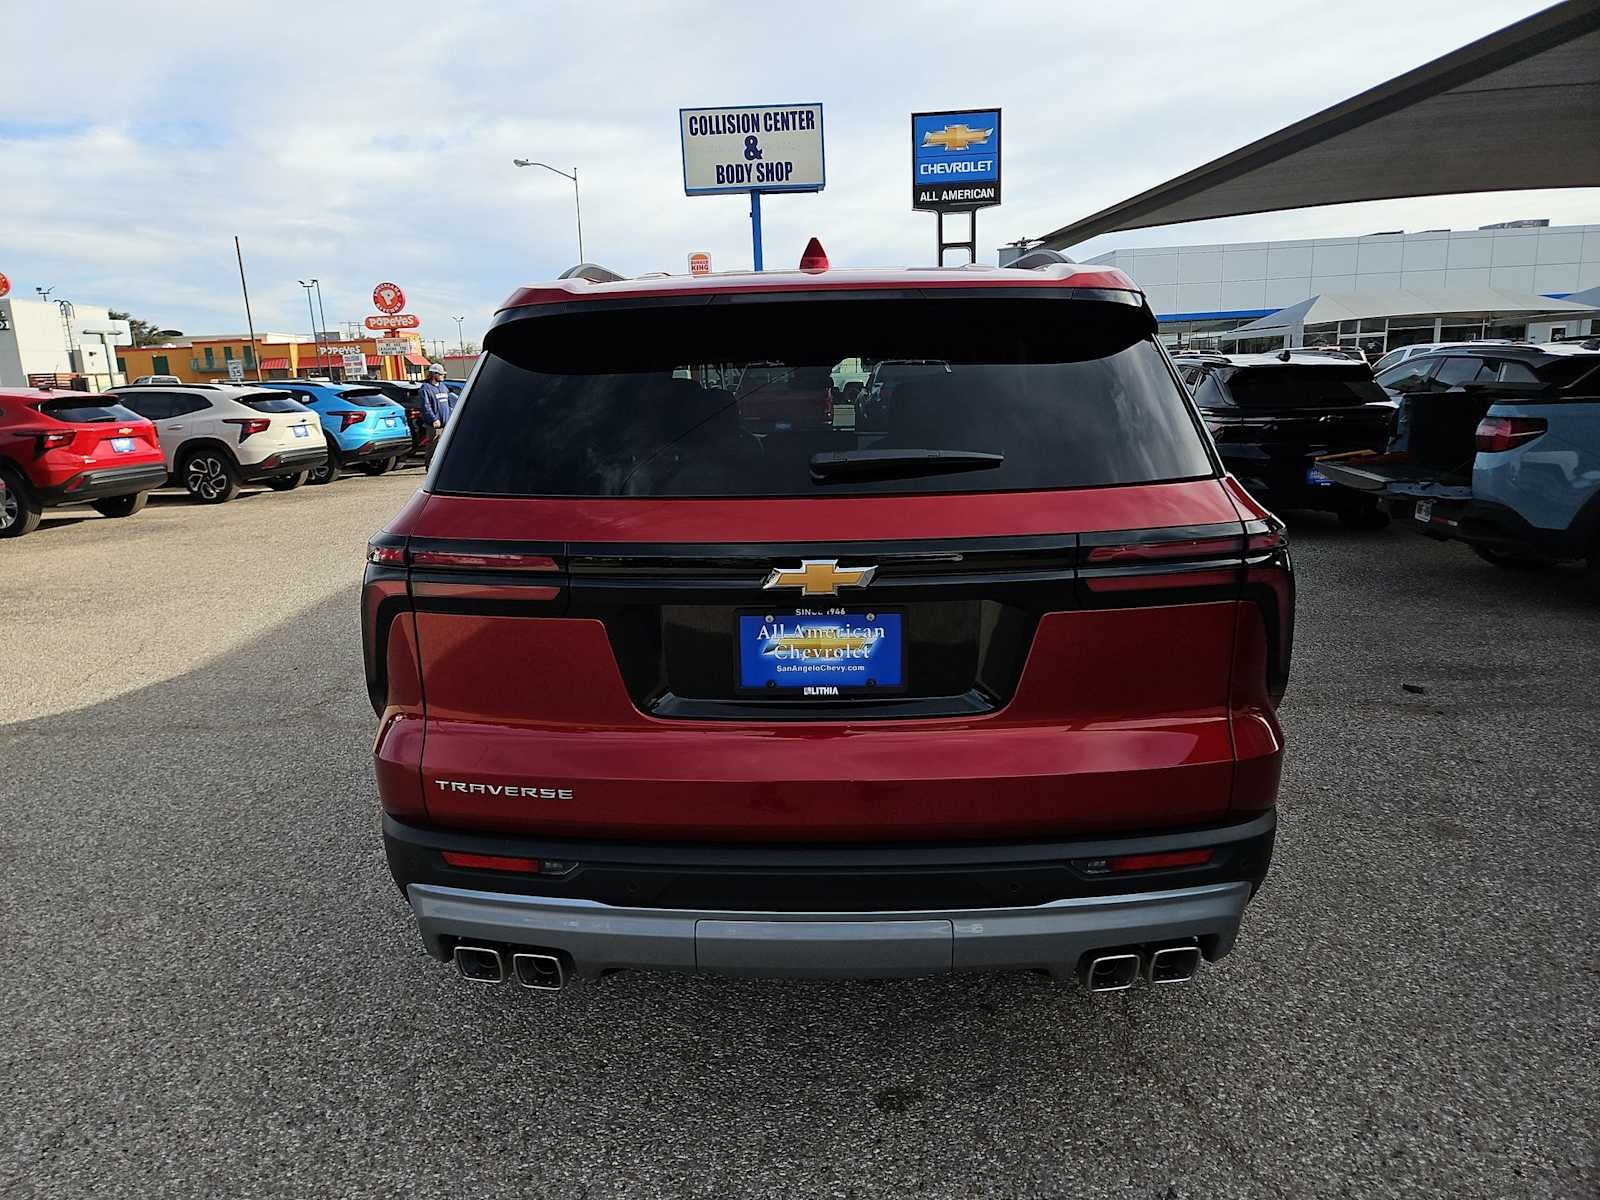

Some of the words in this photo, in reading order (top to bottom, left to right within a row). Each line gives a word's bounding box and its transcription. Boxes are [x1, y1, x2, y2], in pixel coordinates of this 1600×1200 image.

[689, 113, 760, 136] COLLISION
[764, 110, 815, 132] CENTER
[744, 135, 763, 160] &
[716, 163, 753, 184] BODY
[756, 161, 793, 183] SHOP
[920, 160, 992, 175] CHEVROLET
[920, 191, 939, 202] ALL
[941, 188, 995, 201] AMERICAN
[757, 624, 785, 640] All
[793, 623, 885, 640] American
[774, 644, 871, 660] Chevrolet
[776, 664, 865, 673] SanAngeloChevy.com
[435, 780, 574, 800] TRAVERSE
